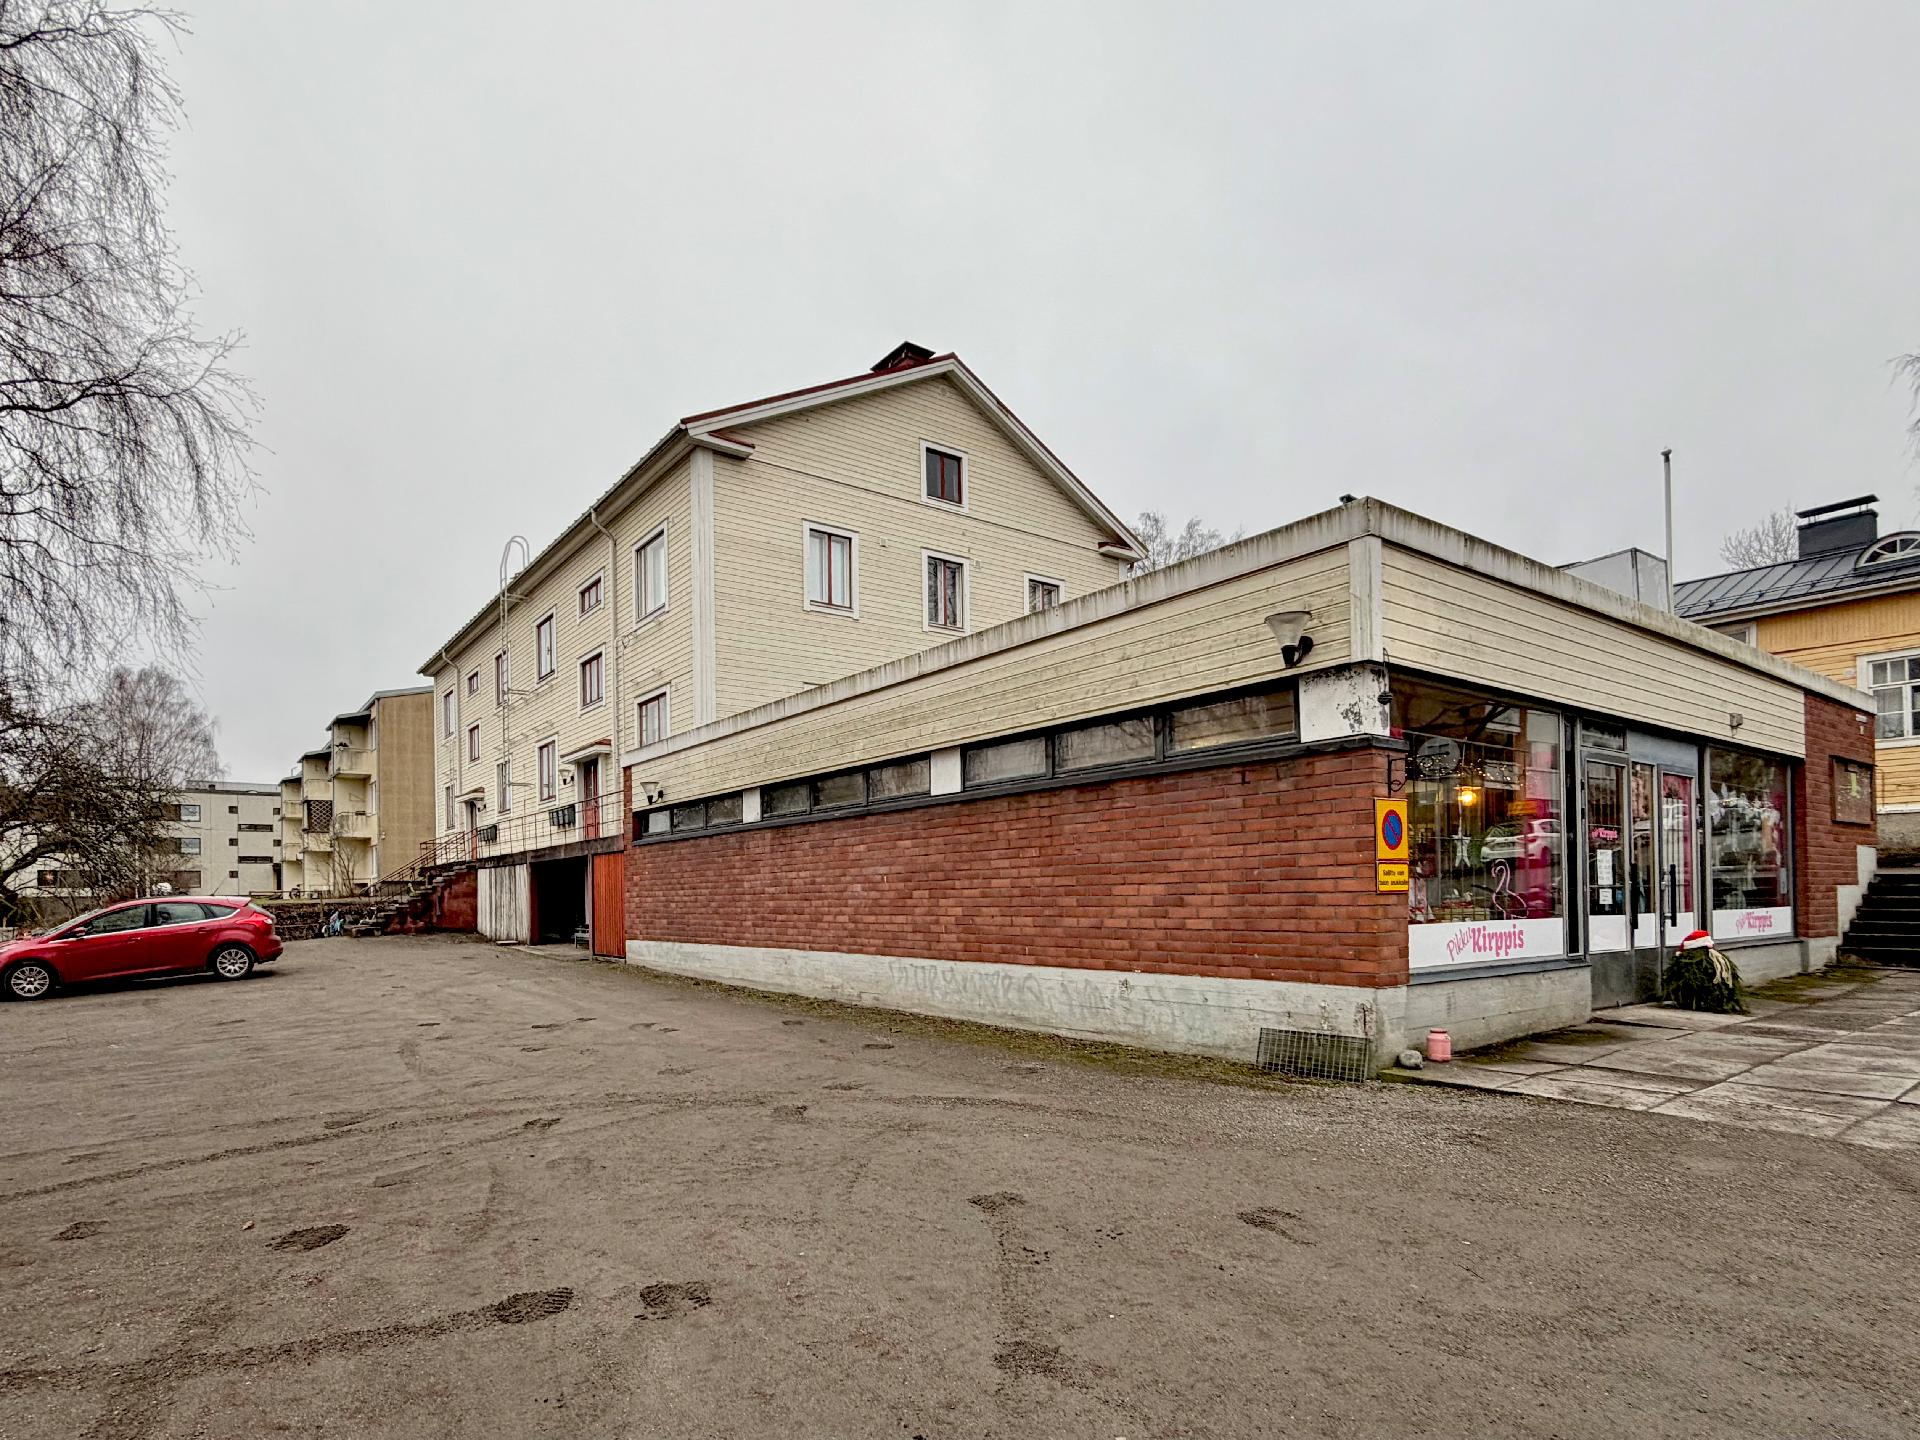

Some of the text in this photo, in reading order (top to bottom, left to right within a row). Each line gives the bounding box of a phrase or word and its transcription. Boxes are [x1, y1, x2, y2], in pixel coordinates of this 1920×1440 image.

[1746, 911, 1772, 933] Kirppis
[1446, 923, 1524, 962] Pikku Kirppis
